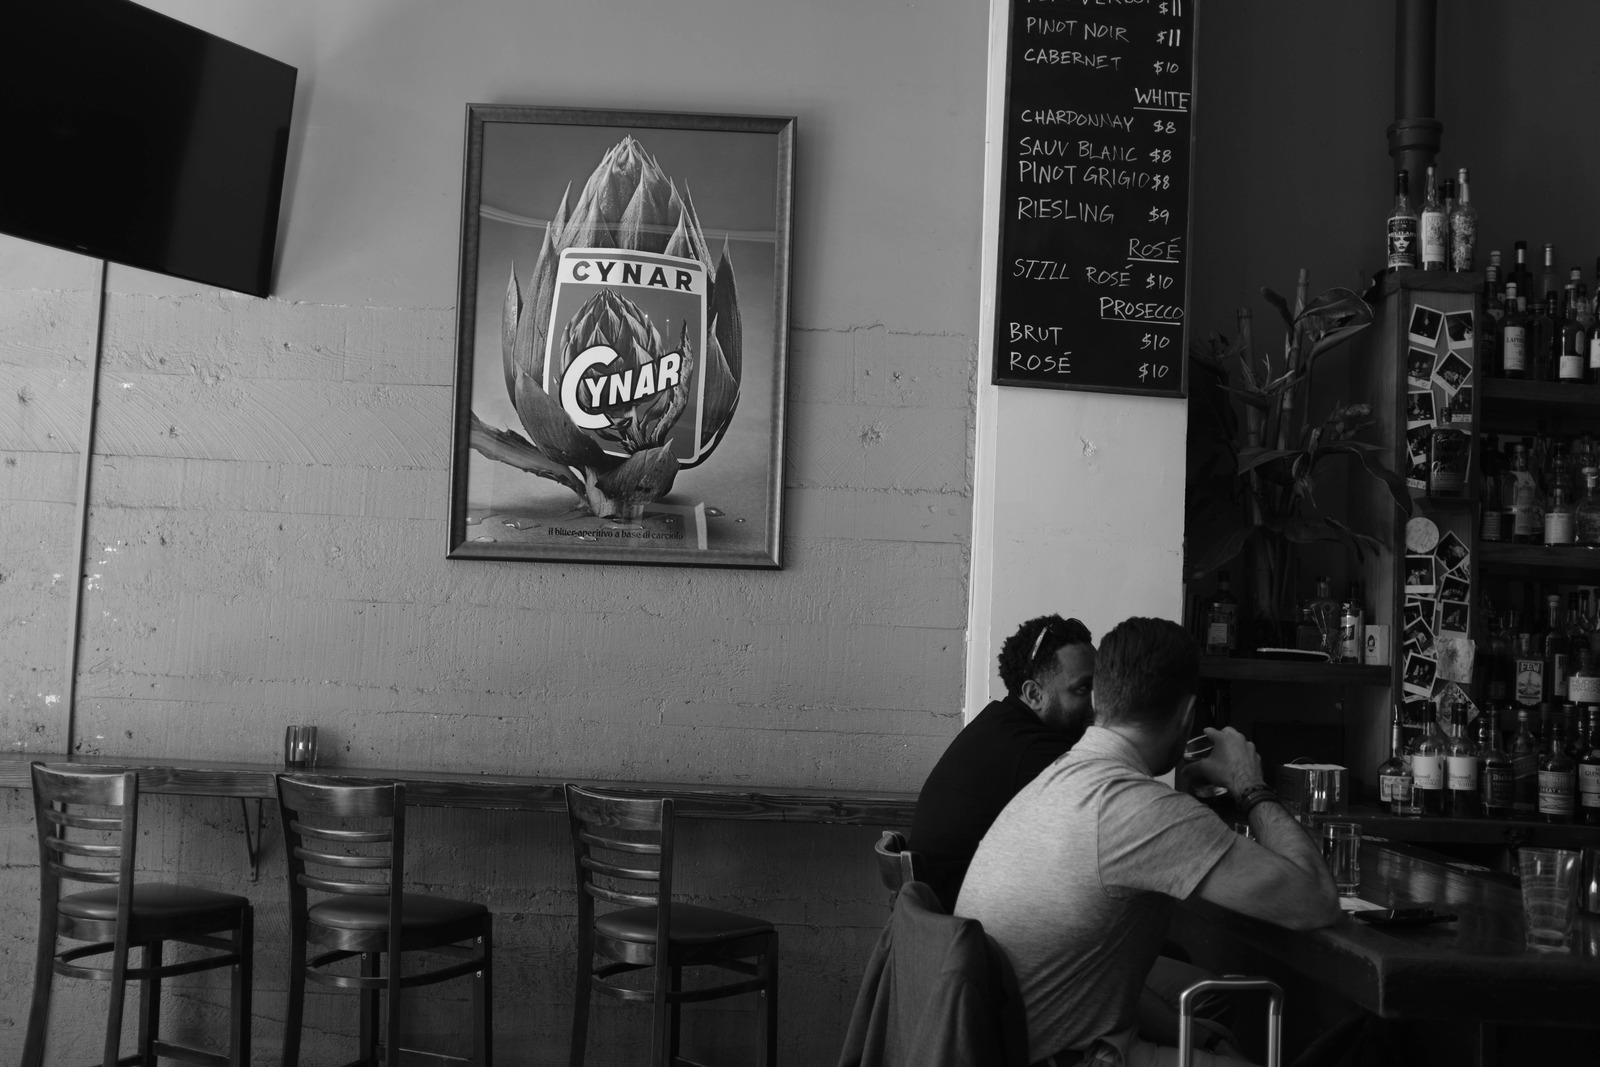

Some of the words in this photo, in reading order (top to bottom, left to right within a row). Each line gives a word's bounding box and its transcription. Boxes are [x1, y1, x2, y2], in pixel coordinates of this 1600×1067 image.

[1159, 0, 1182, 17] $11
[1027, 17, 1078, 36] PINOT
[1084, 23, 1129, 43] NOIR
[1157, 29, 1181, 47] $11
[1024, 48, 1122, 71] CABERNET
[1153, 61, 1179, 75] $10
[1134, 87, 1191, 109] WHITE
[1021, 109, 1134, 132] CHARDONNAY
[1153, 120, 1176, 134] $8
[1019, 137, 1069, 156] SAUV
[1078, 140, 1138, 162] BLANC
[1149, 148, 1172, 163] $8
[1019, 160, 1078, 185] PINOT
[1083, 166, 1150, 189] GRIGIO
[1151, 174, 1170, 191] $8
[1018, 196, 1114, 225] RIESLING
[1149, 206, 1169, 225] $9
[1128, 237, 1181, 259] ROSÉ
[572, 260, 692, 292] CYNAR
[1013, 258, 1070, 280] STILL
[1086, 264, 1133, 287] ROSÉ
[1146, 273, 1173, 289] $10
[1100, 297, 1184, 320] PROSECCO
[1010, 322, 1063, 346] BRUT
[1140, 333, 1170, 350] $10
[1010, 351, 1072, 373] ROSÉ
[1138, 363, 1169, 383] $10
[622, 529, 641, 538] base
[643, 530, 650, 539] di
[1521, 662, 1540, 672] FEW
